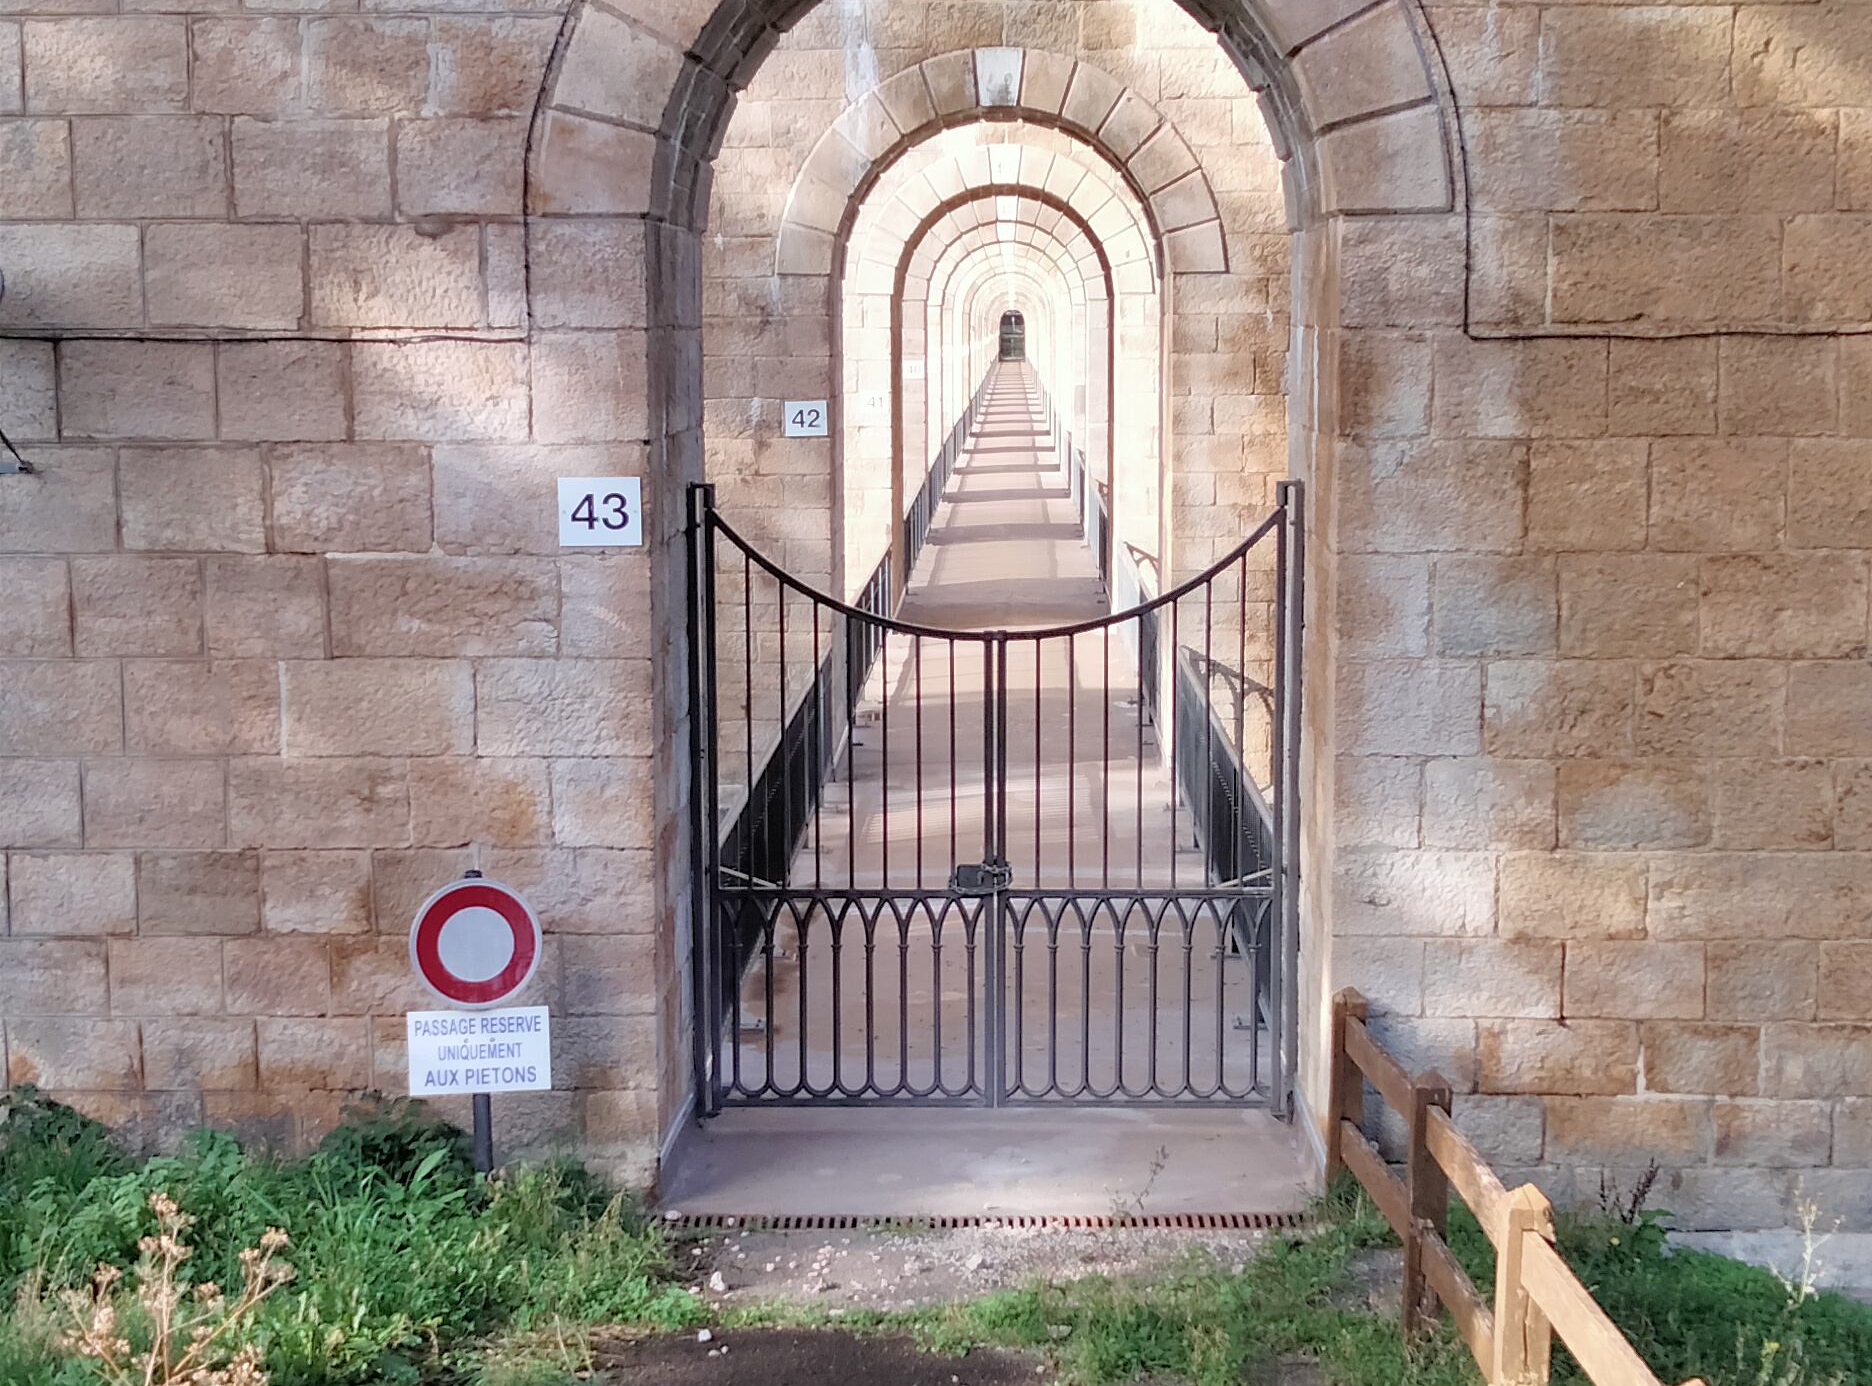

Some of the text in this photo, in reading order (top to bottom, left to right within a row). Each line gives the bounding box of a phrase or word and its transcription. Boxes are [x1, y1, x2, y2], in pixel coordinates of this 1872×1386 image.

[867, 396, 884, 408] 41
[791, 408, 820, 428] 42
[570, 493, 629, 530] 43
[414, 1015, 542, 1037] PASSAGE RESERVE
[437, 1042, 523, 1061] UNIQUEMENT
[424, 1065, 537, 1087] AUX PIETONS
